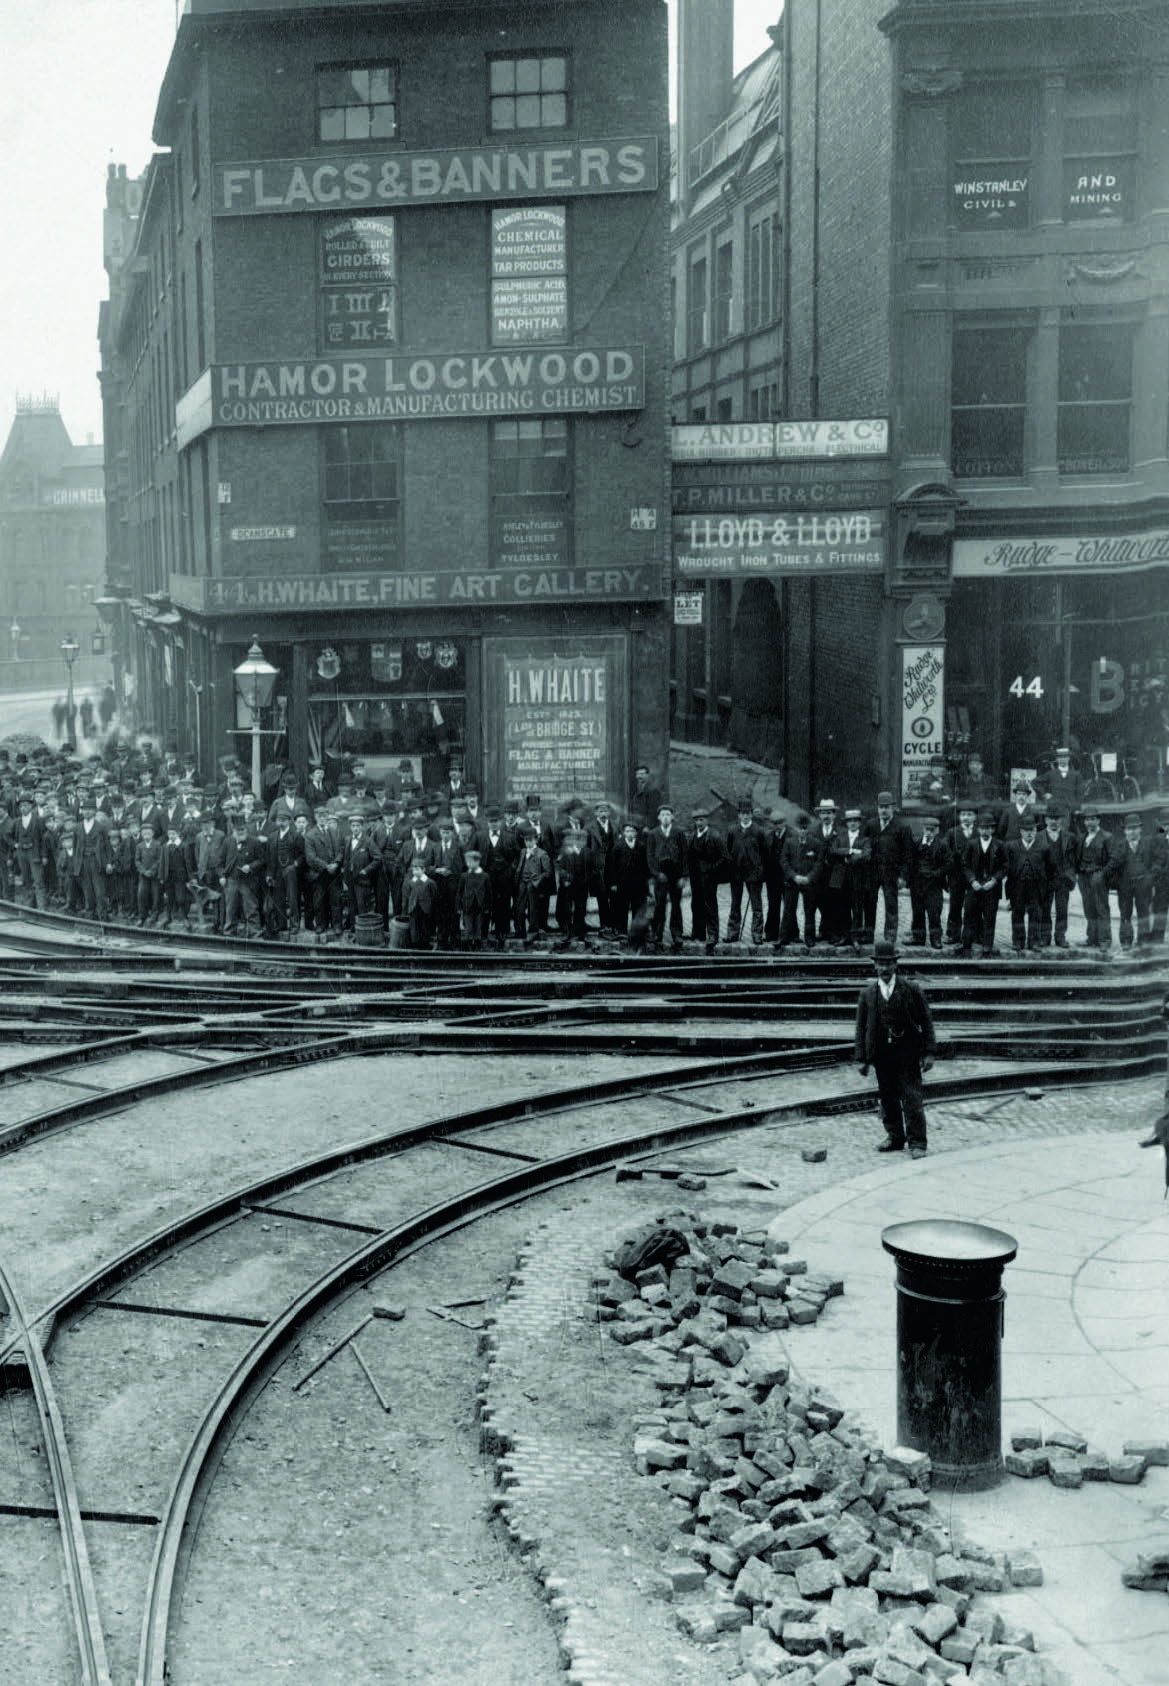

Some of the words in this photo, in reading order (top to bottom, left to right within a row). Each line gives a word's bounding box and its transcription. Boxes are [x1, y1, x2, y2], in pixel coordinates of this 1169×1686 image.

[223, 163, 372, 208] FLAGS
[376, 160, 409, 199] &
[411, 145, 646, 197] BANNERS
[954, 178, 1028, 195] WINSTANLEY
[1077, 174, 1117, 190] AND
[963, 199, 1006, 210] CIVIL
[1070, 192, 1122, 204] MINING
[493, 211, 523, 231] HAMOR
[523, 208, 565, 228] LOCKWOOD
[497, 230, 563, 243] CHEMICAL
[327, 252, 391, 268] GIRDERS
[495, 261, 513, 273] TAR
[221, 363, 368, 398] HAMOR
[384, 351, 635, 392] LOCKWOOD
[219, 399, 352, 421] CONTRACTOR
[366, 389, 533, 416] MANUFACTURING
[827, 424, 847, 442] &
[690, 518, 764, 549] LLOYD
[771, 517, 791, 547] &
[797, 515, 871, 547] LLOYD
[677, 555, 734, 569] WROUGHT
[740, 553, 768, 567] IRON
[773, 552, 810, 566] TUBES
[815, 553, 825, 564] &
[828, 550, 882, 565] FITTINGS
[983, 541, 1058, 568] Rudge
[380, 575, 437, 600] FINE
[448, 574, 502, 598] ART
[904, 650, 933, 688] Rudge
[1009, 675, 1045, 699] 44
[536, 720, 575, 737] BRIDGE
[508, 749, 541, 760] FLAG
[557, 748, 601, 760] BANNER
[903, 742, 941, 755] CYCLE
